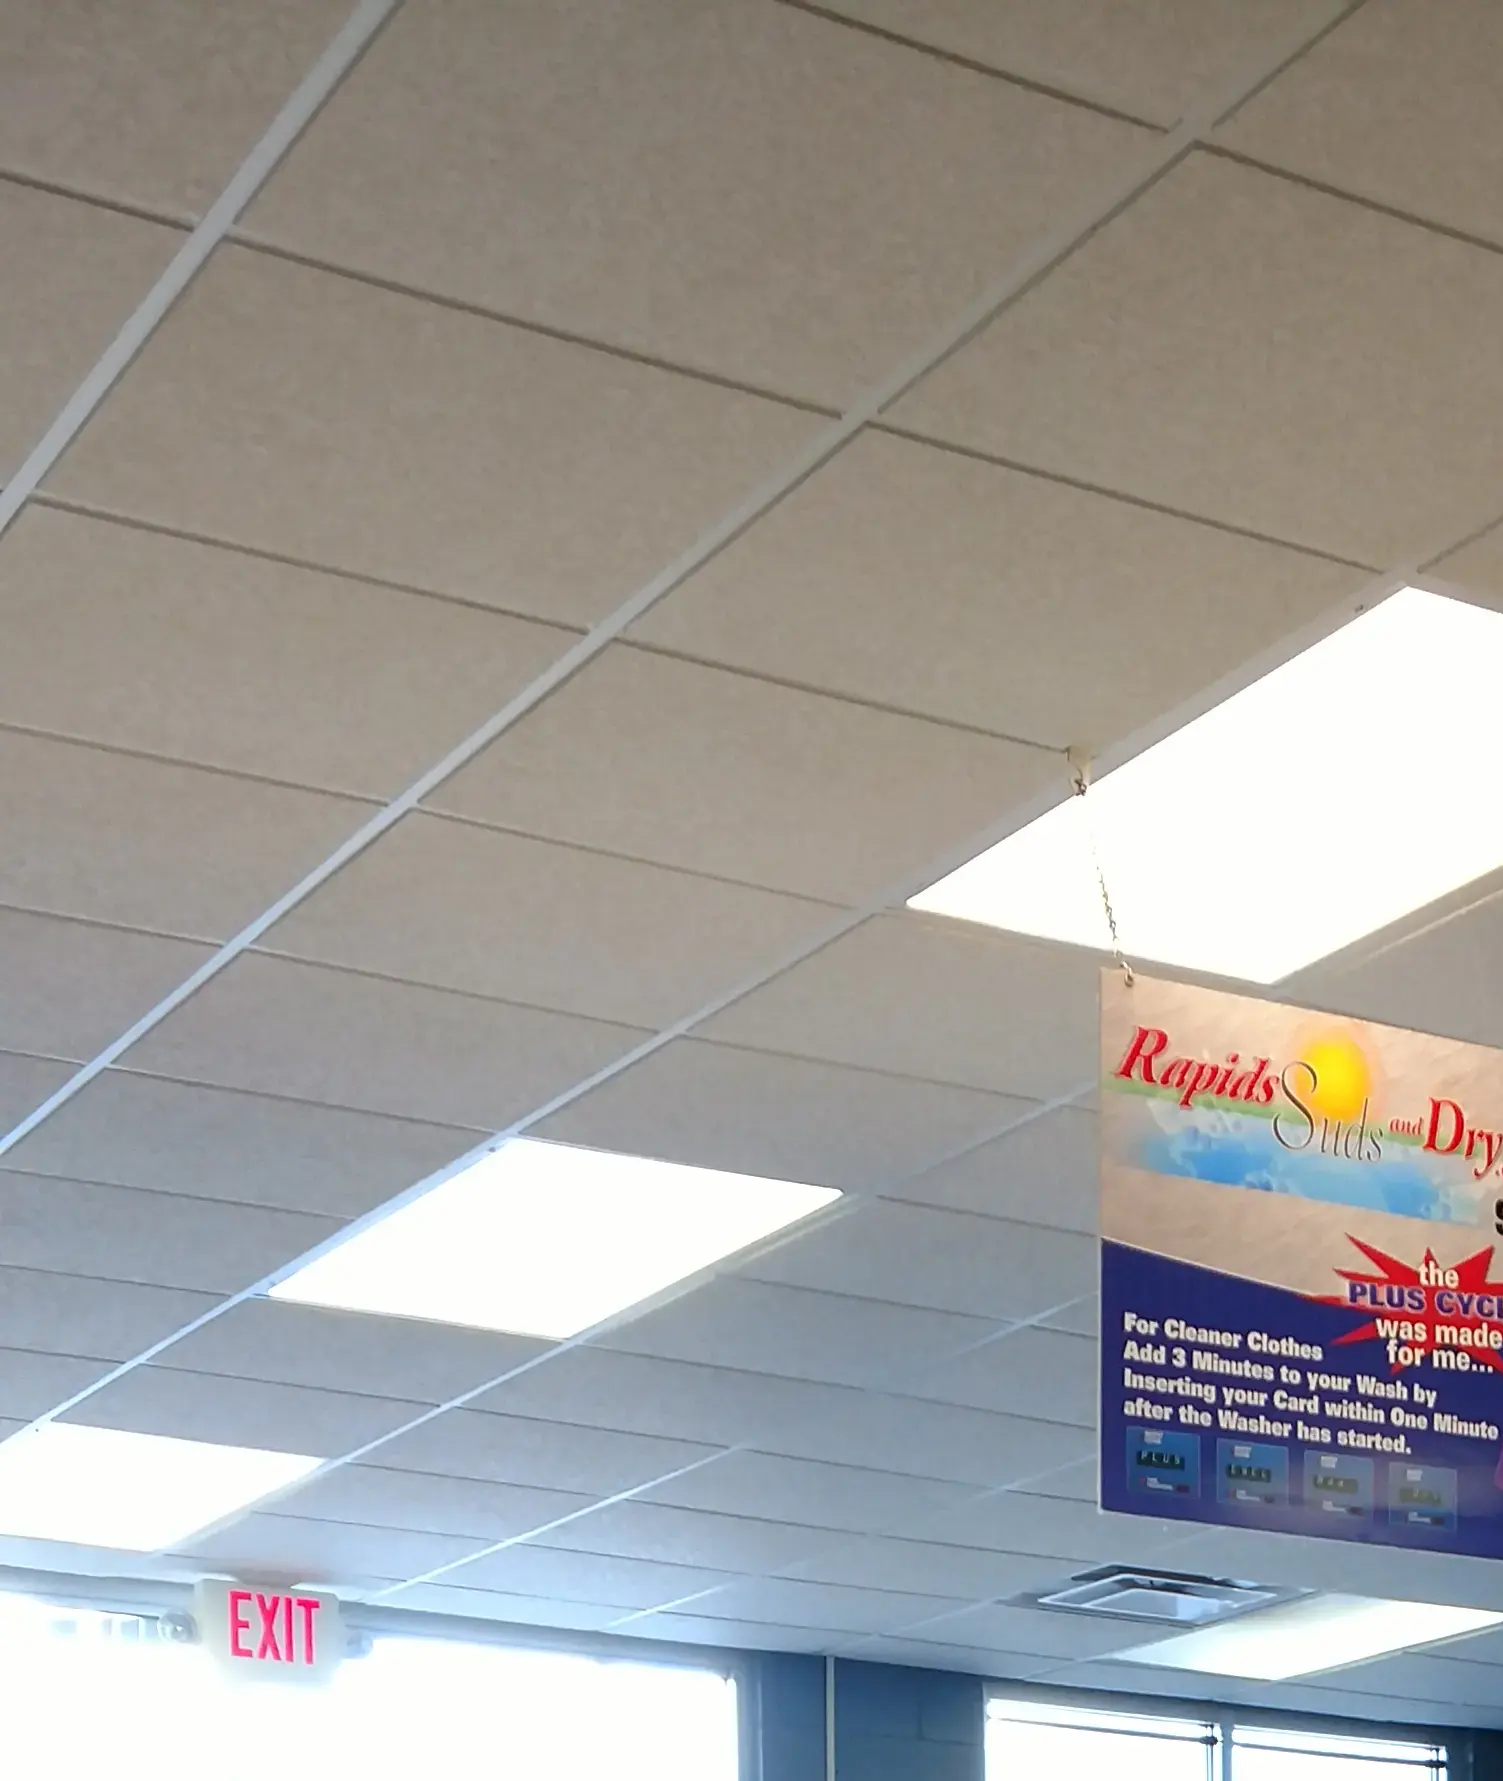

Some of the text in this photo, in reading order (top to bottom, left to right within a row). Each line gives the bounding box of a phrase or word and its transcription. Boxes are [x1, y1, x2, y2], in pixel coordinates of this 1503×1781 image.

[1114, 1025, 1279, 1110] Rapids
[1272, 1061, 1384, 1162] Suds
[1389, 1116, 1422, 1137] and
[1348, 1281, 1425, 1311] PLUS
[1418, 1259, 1459, 1289] the
[1123, 1312, 1323, 1361] For Cleaner Clothes
[1375, 1317, 1503, 1349] was made
[1387, 1339, 1493, 1373] for me...
[1123, 1340, 1437, 1408] Add 3 Minutes to your Wash by
[1123, 1368, 1499, 1441] Inserting your Card within One Minute
[1123, 1398, 1412, 1455] after the Washer has started.
[228, 1589, 320, 1665] EXIT
